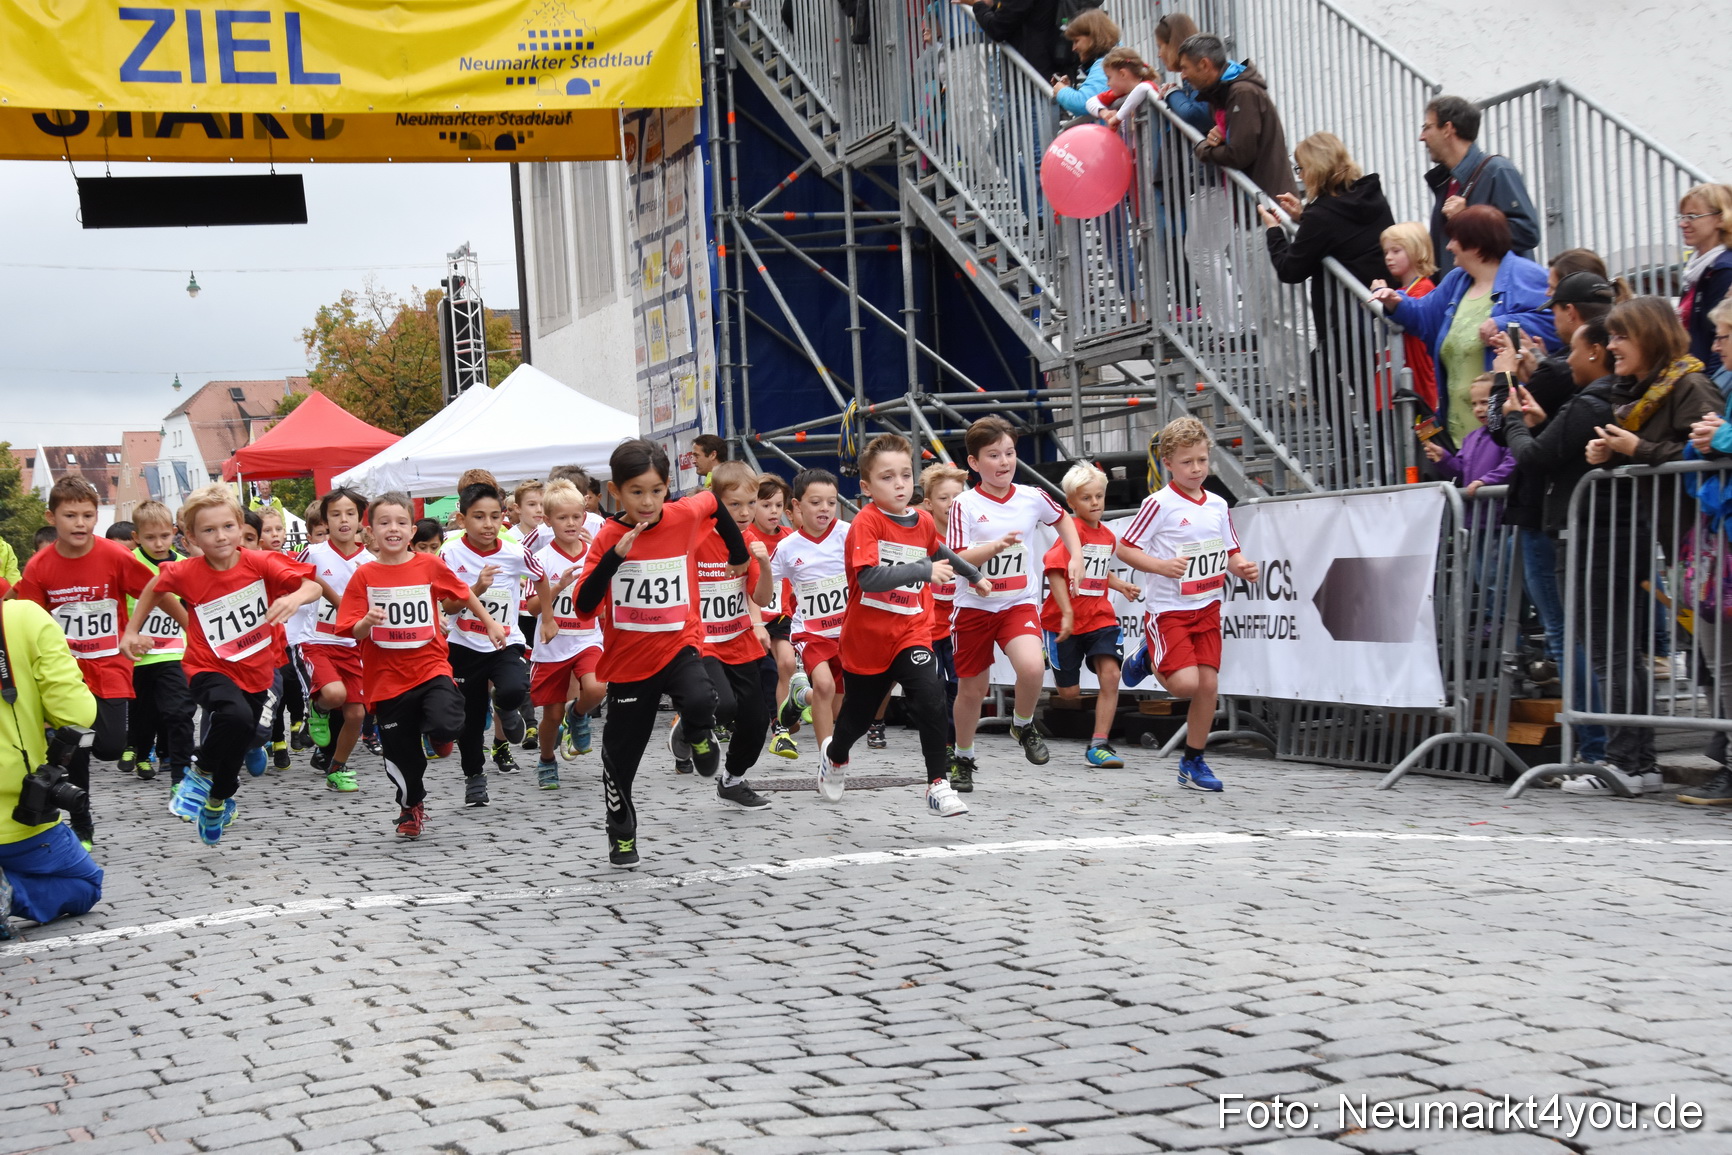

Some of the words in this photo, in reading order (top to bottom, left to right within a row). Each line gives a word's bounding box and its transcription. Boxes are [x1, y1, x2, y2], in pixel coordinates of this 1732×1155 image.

[118, 7, 341, 85] ZIEL
[459, 57, 565, 71] Neumarkter
[570, 51, 653, 69] Stadtlauf
[395, 113, 494, 126] Neumarkter
[499, 111, 572, 126] Stadtlauf
[647, 560, 682, 572] BOCK
[978, 553, 1022, 576] 071
[1188, 550, 1226, 578] 7072
[620, 575, 681, 604] 7431
[1196, 580, 1220, 592] Hannes
[700, 591, 744, 619] 7062
[889, 592, 910, 605] Paul
[60, 612, 112, 637] 7150
[208, 596, 268, 641] 7154
[559, 620, 581, 629] Jonas
[389, 630, 417, 640] Niklas
[706, 622, 743, 635] Christoph
[72, 642, 100, 652] Adrian
[236, 632, 263, 650] Kilian
